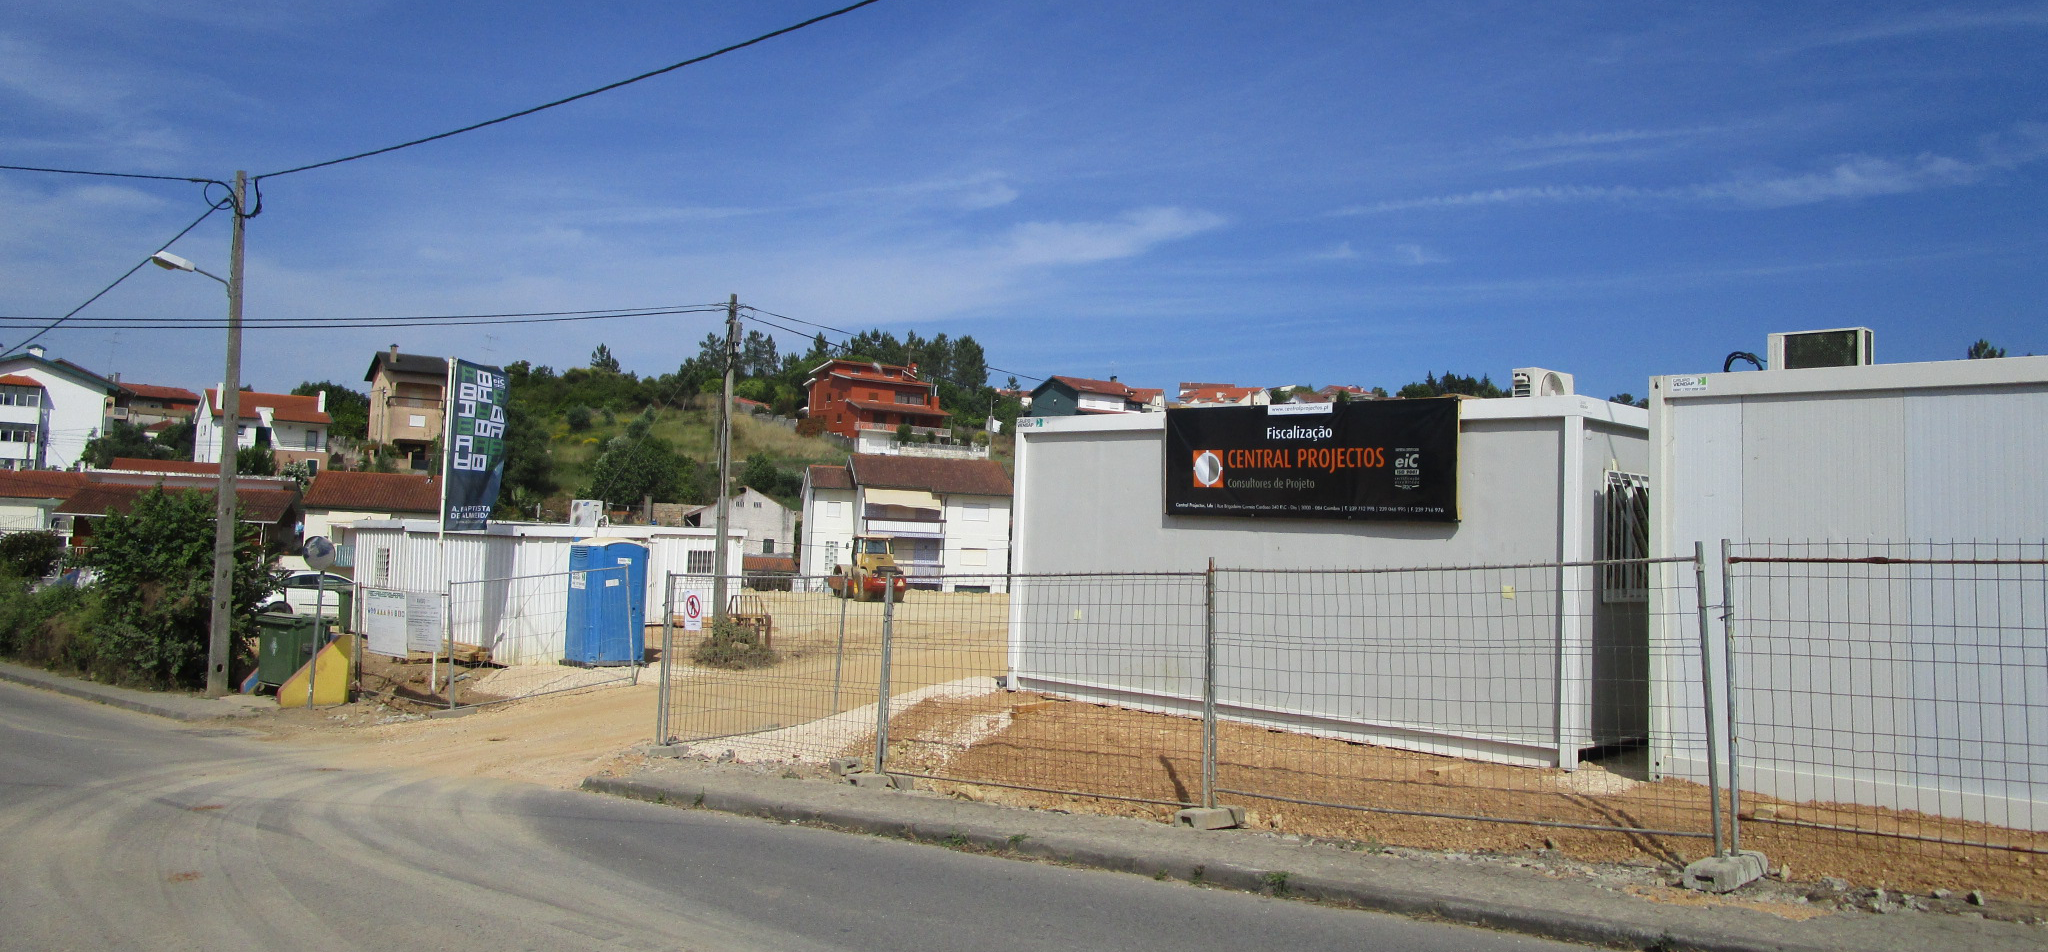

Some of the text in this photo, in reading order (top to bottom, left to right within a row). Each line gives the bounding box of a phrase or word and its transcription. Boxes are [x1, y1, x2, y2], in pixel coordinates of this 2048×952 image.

[1266, 425, 1333, 441] Fiscalização
[1228, 447, 1385, 473] CENTRAL PROJECTOS
[1395, 453, 1420, 468] eiC
[1228, 478, 1315, 491] Consultores de Projeto
